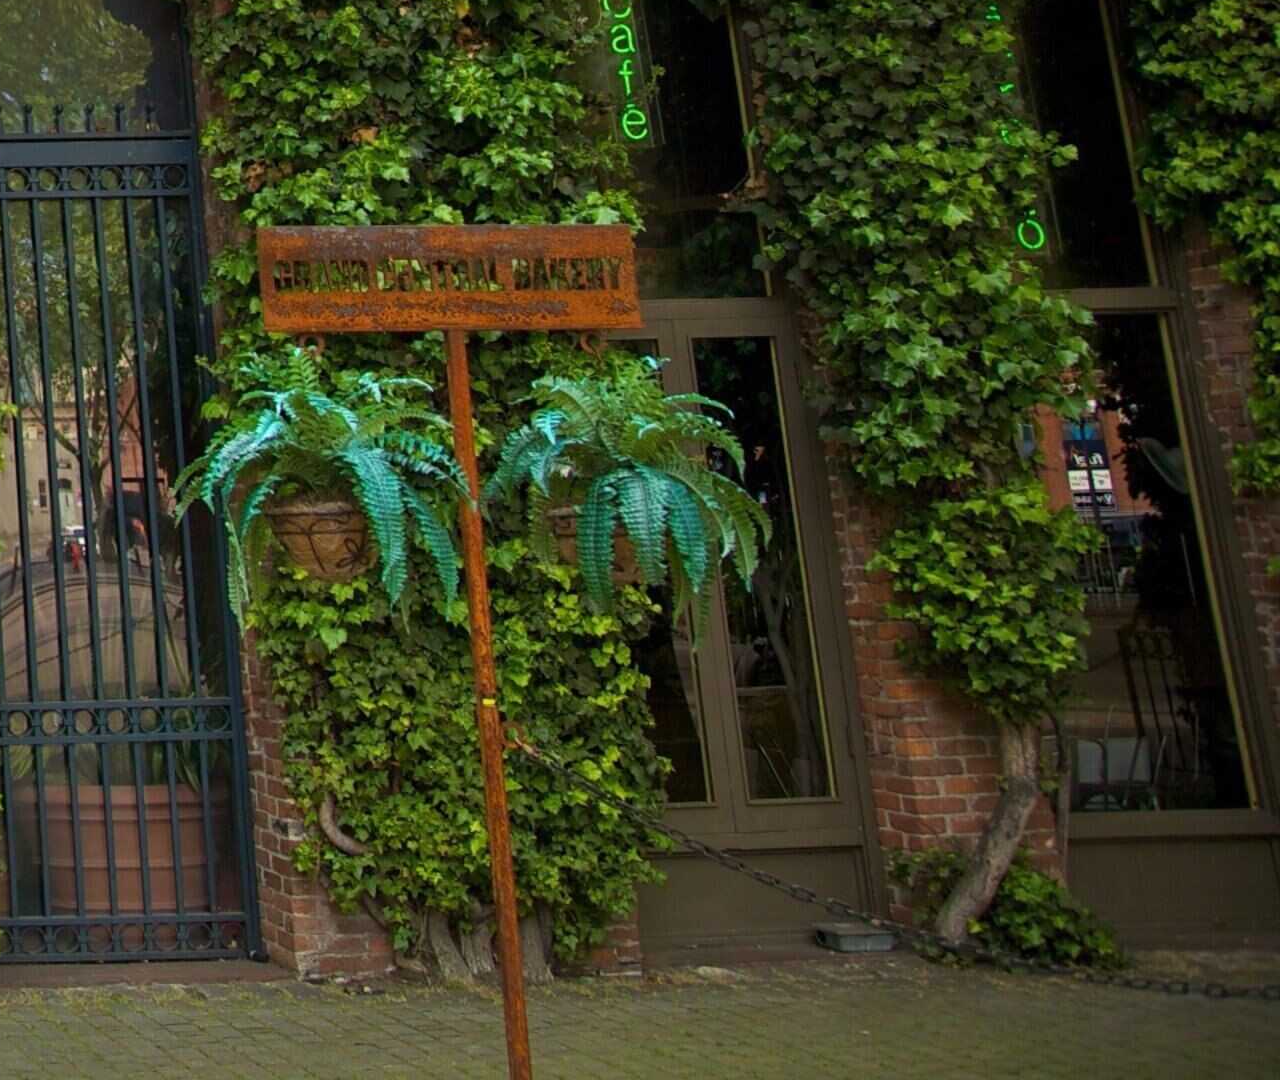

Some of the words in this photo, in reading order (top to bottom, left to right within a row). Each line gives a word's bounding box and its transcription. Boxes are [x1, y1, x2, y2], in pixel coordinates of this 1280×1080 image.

[272, 259, 371, 294] GRAND
[375, 259, 504, 294] CENTRAL
[511, 256, 623, 292] BAKERY
